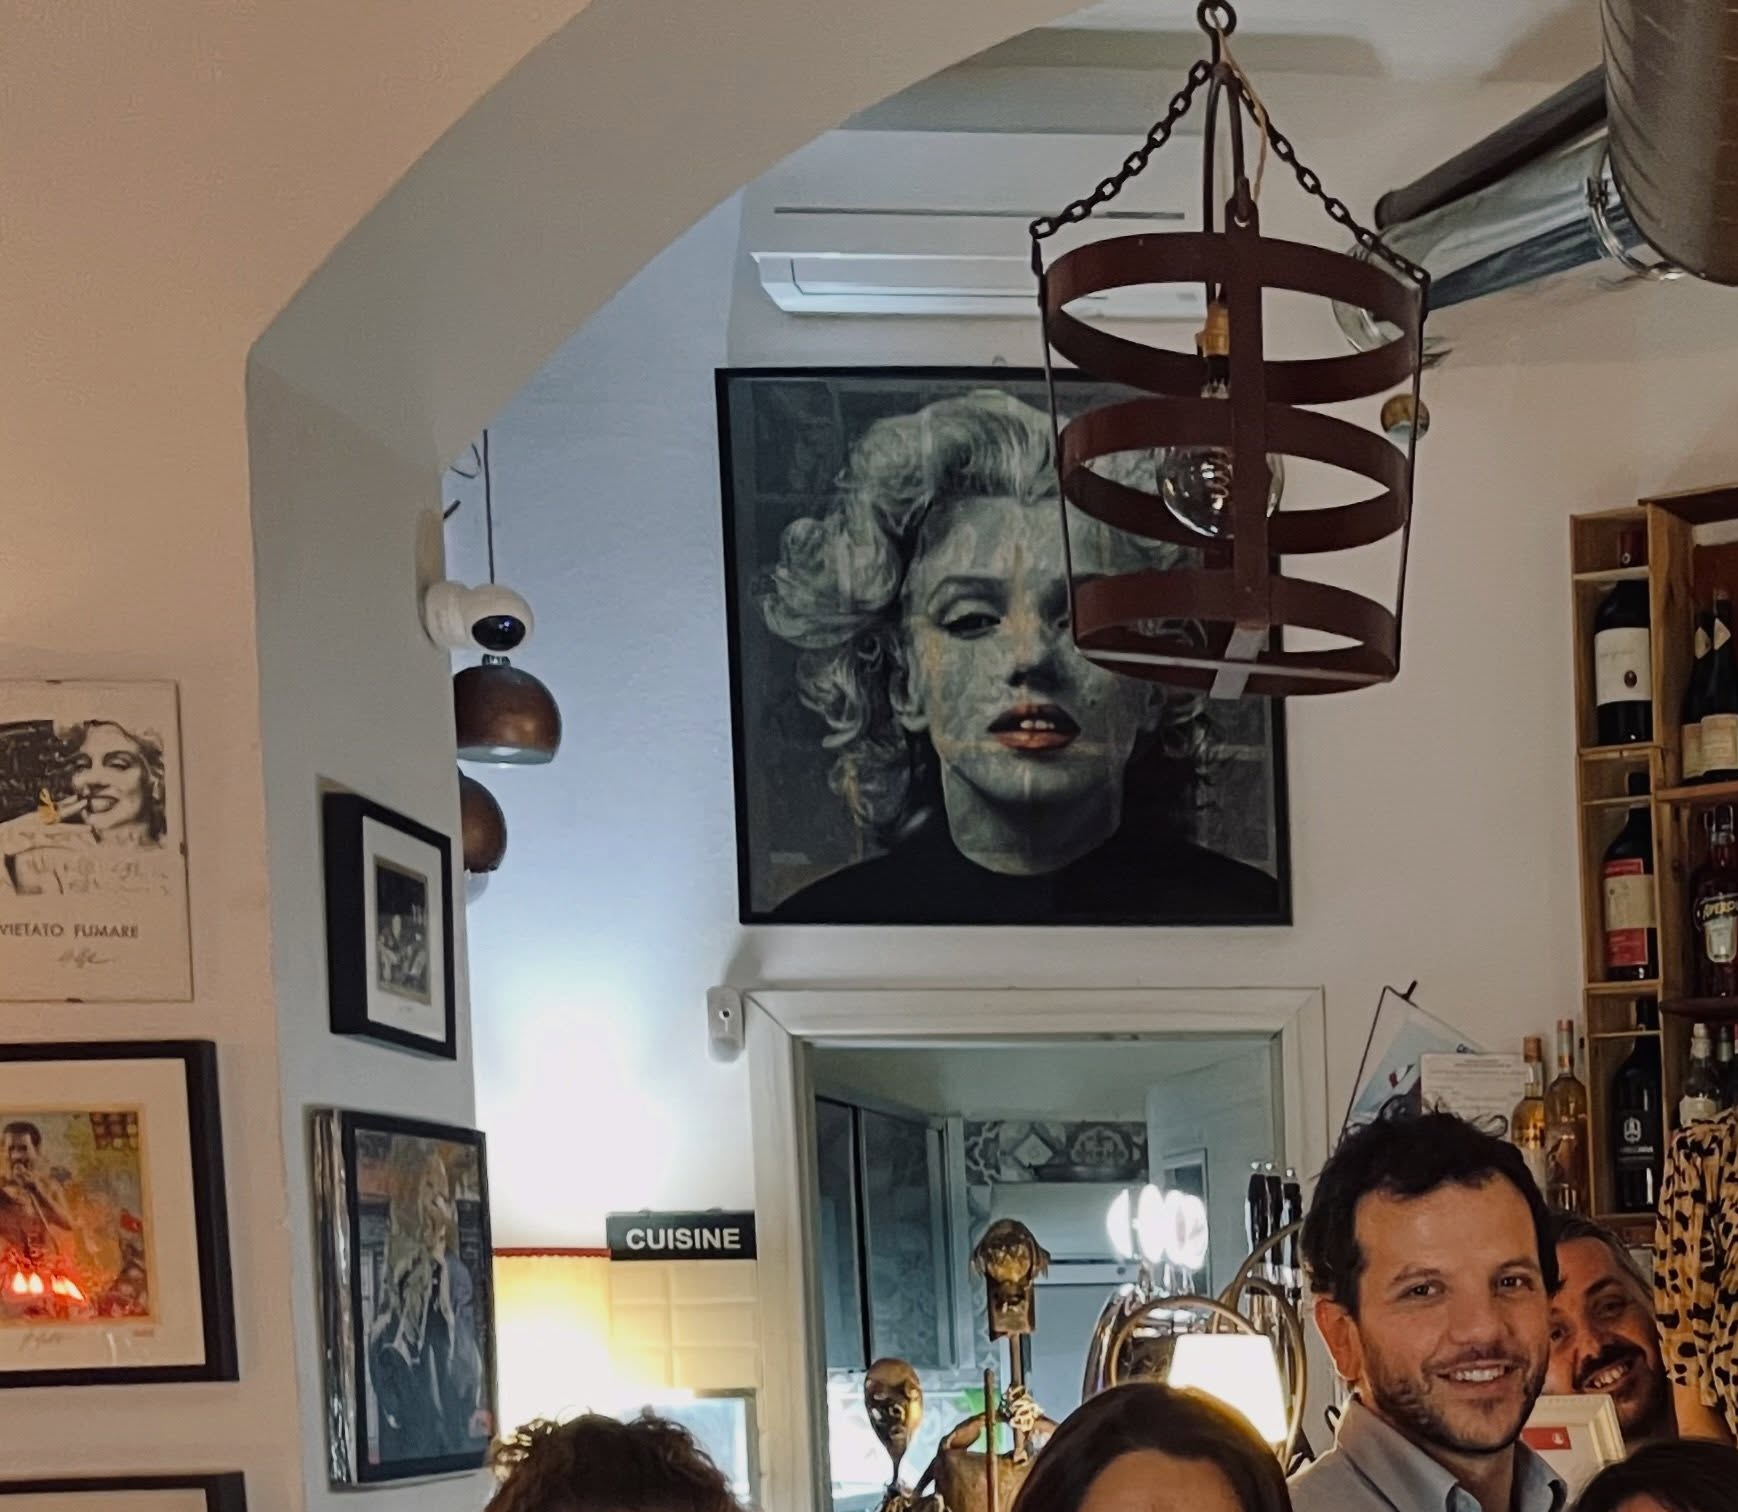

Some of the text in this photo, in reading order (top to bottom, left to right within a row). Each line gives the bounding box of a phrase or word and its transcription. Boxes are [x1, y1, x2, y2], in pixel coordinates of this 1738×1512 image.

[0, 922, 139, 938] VIETATO FUMARE
[626, 1227, 742, 1250] CUISINE
